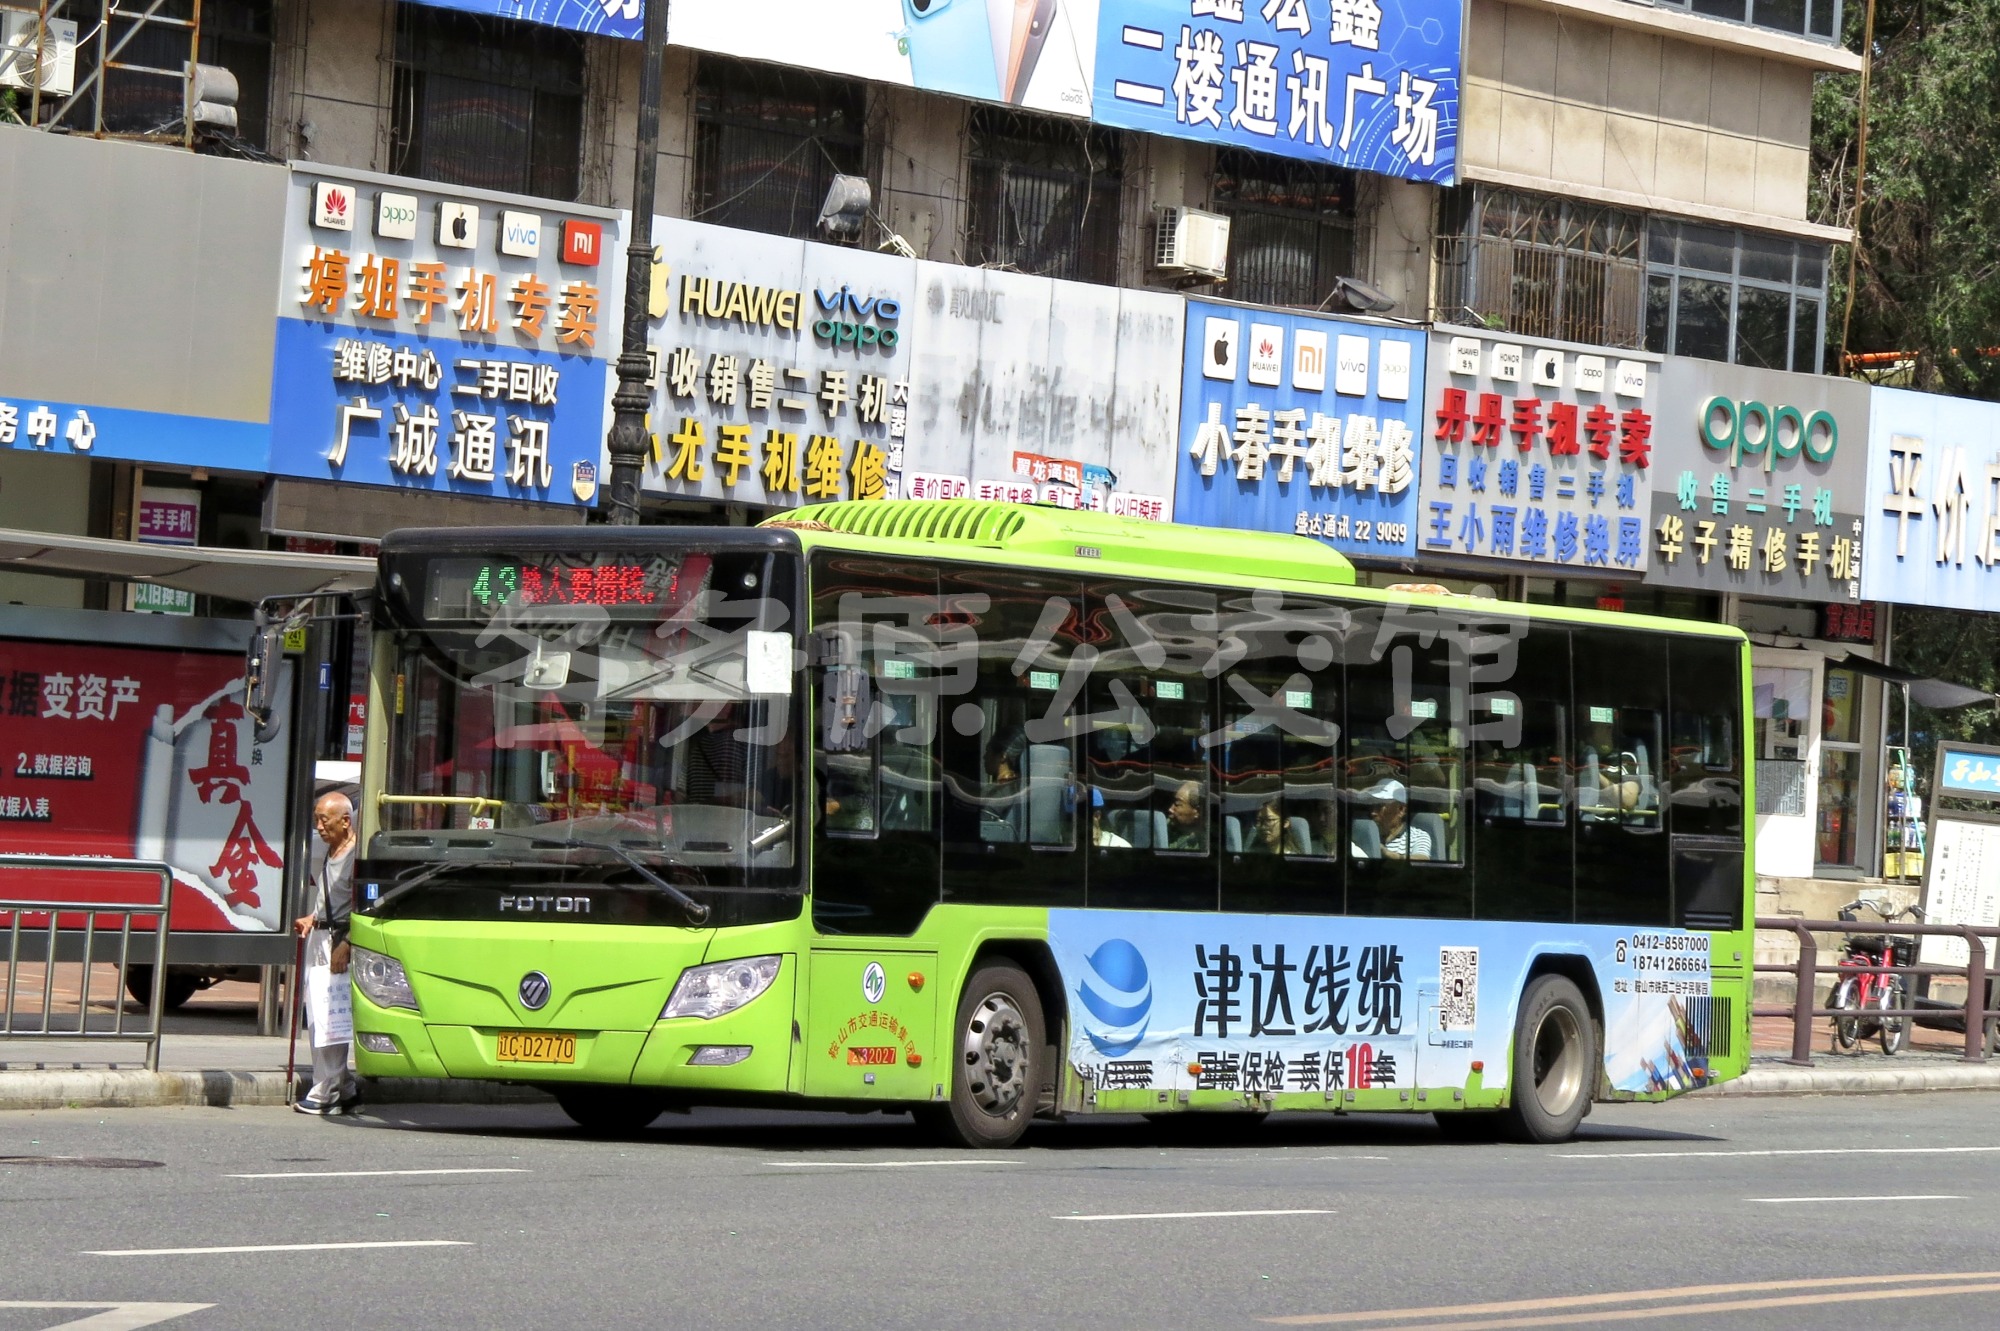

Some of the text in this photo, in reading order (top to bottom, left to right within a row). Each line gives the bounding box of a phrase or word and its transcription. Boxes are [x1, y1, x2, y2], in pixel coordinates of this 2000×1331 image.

[1114, 24, 1440, 168] 二楼通讯广场
[323, 215, 346, 226] HUAWEI
[507, 222, 537, 245] vivo
[301, 245, 600, 348] 婷姐手机专卖
[681, 274, 803, 330] HUAWEI
[815, 285, 900, 320] vivo
[1252, 360, 1279, 373] HUAWEI
[1340, 360, 1366, 374] vivo
[1457, 346, 1479, 358] HUAWEI
[1462, 360, 1473, 370] 华为
[1500, 353, 1520, 364] HONOR
[334, 338, 559, 405] 维修中心 二手回收
[1623, 375, 1644, 386] vivo
[327, 397, 553, 488] 广诚通讯
[1435, 388, 1652, 469] 丹丹手机专卖
[1190, 402, 1414, 494] 小春手机维修
[1015, 457, 1080, 487] 翼龙通讯
[1439, 454, 1636, 509] 回收销售二手机
[912, 476, 966, 500] 高价回收
[980, 484, 1033, 505] 手机快修
[1677, 470, 1834, 527] 收售二手机
[140, 508, 192, 532] 二手手机
[1115, 497, 1162, 522] 以旧换新
[1295, 511, 1407, 542] 盛达通讯 22 9099
[1426, 501, 1642, 567] 王小雨维修换屏
[1655, 514, 1851, 581] 华子精修手机
[473, 566, 517, 605] 43
[0, 670, 141, 721] 据变资产
[17, 752, 92, 777] 2.数据咨询
[188, 694, 284, 909] 真金
[499, 895, 591, 914] FOTON
[1633, 934, 1708, 951] 0412-8587000
[1633, 955, 1707, 972] 18741266664
[1193, 943, 1404, 1039] 津达线缆
[828, 1010, 916, 1059] 鞍山市交通运输集团
